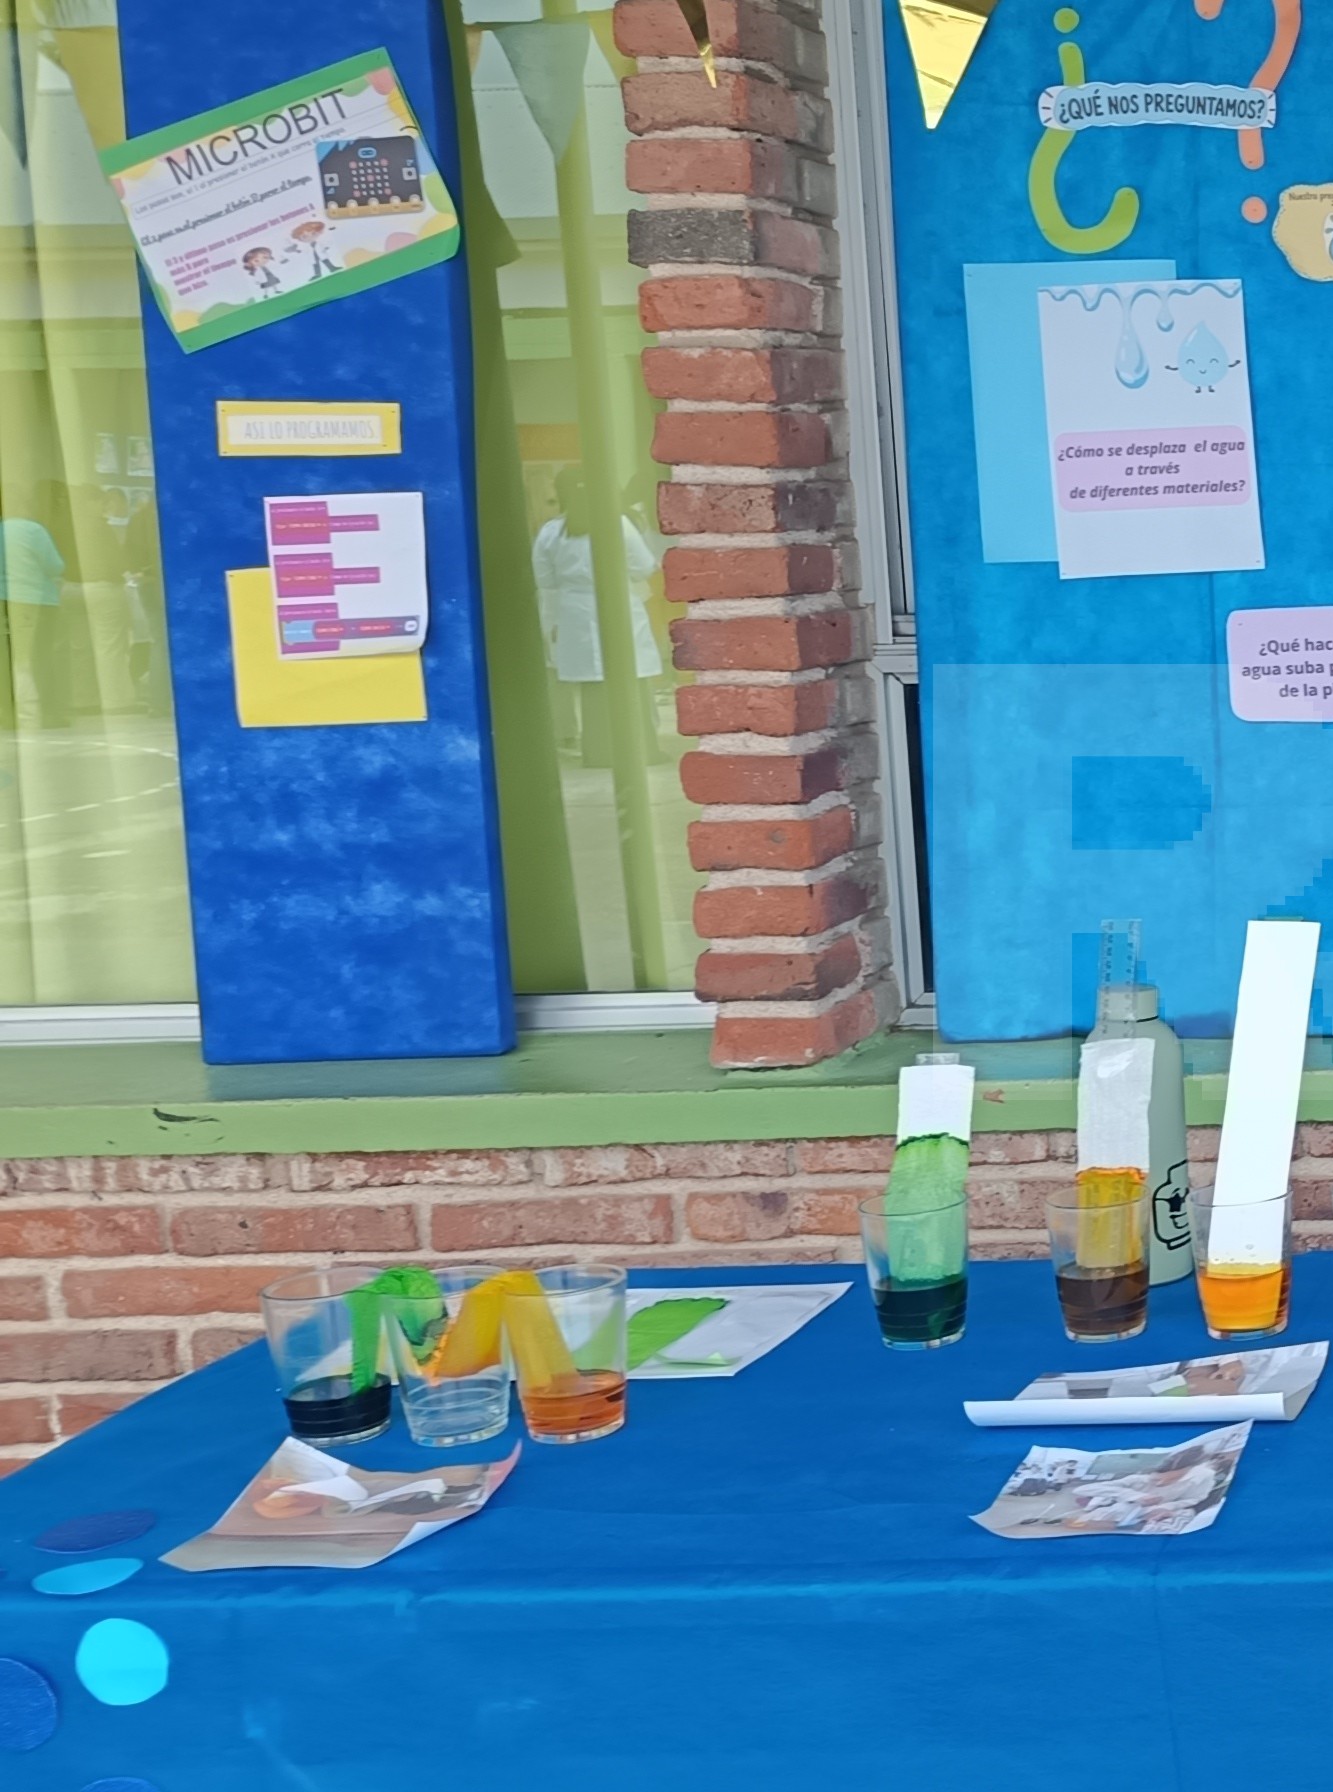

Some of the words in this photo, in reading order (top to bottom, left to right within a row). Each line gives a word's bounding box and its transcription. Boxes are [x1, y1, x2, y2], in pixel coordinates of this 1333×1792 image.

[1059, 89, 1103, 124] ¿QUÉ
[1108, 94, 1138, 115] NOS
[1144, 93, 1265, 119] PREGUNTAMOS?
[164, 88, 348, 185] MICROBIT
[1057, 446, 1104, 461] ¿Cómo
[1107, 447, 1122, 456] se
[1126, 442, 1186, 458] desplaza
[1194, 440, 1207, 452] el
[1211, 441, 1245, 455] agua
[1125, 466, 1133, 476] a
[1137, 462, 1180, 475] través
[1069, 487, 1086, 499] de
[1090, 483, 1159, 501] diferentes
[1162, 480, 1245, 494] materiales?
[1259, 639, 1300, 656] ¿Qué
[1242, 665, 1281, 680] agua
[1286, 661, 1324, 675] suba
[1279, 684, 1299, 697] de
[1304, 684, 1317, 696] la
